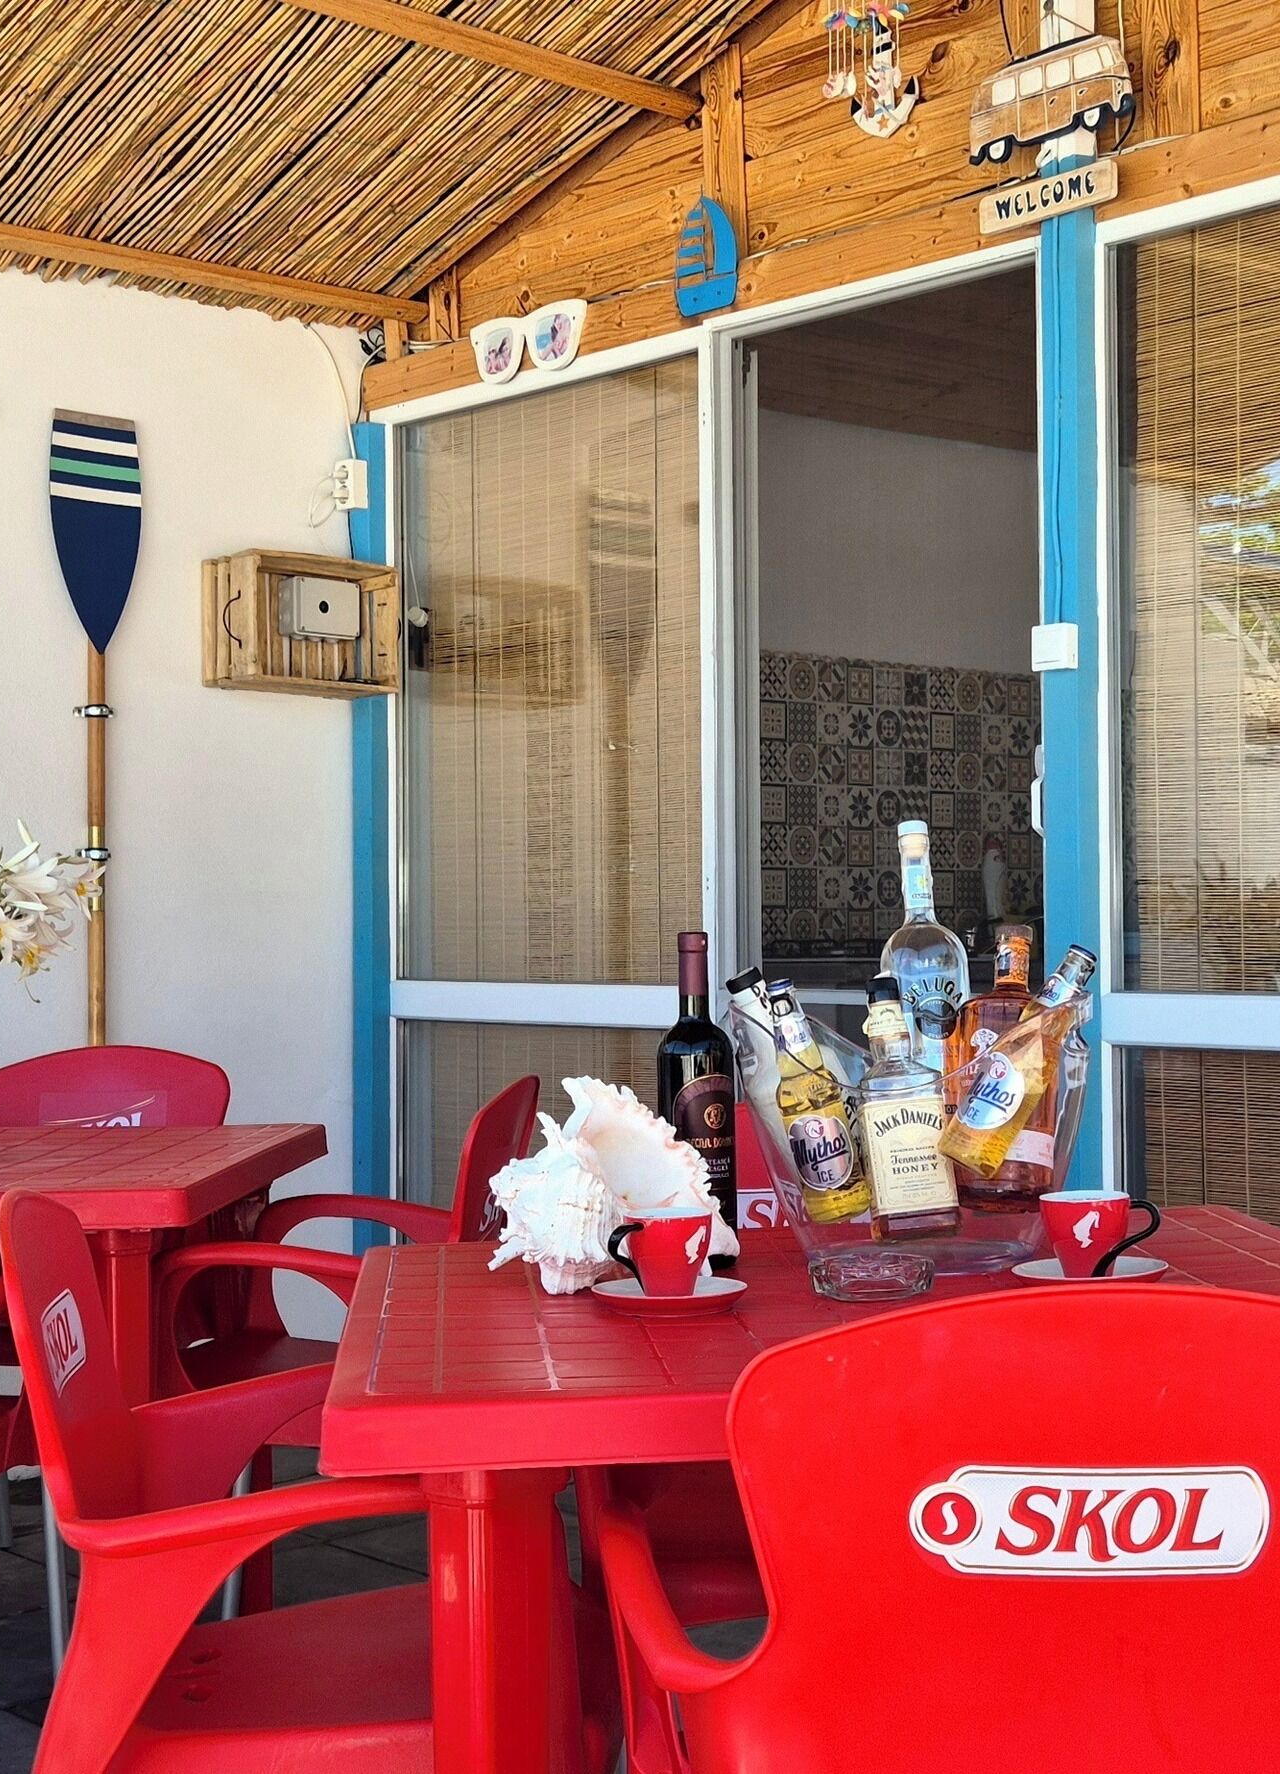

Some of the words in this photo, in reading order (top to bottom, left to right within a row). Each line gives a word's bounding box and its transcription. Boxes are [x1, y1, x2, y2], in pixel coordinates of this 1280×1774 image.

[996, 171, 1095, 220] WELCOME
[902, 977, 963, 1005] BELUGA
[873, 1113, 901, 1137] JACK
[790, 1134, 848, 1171] Mythos
[816, 1169, 835, 1184] ICE
[892, 1162, 938, 1174] HONEY
[995, 1485, 1224, 1563] SKOL
